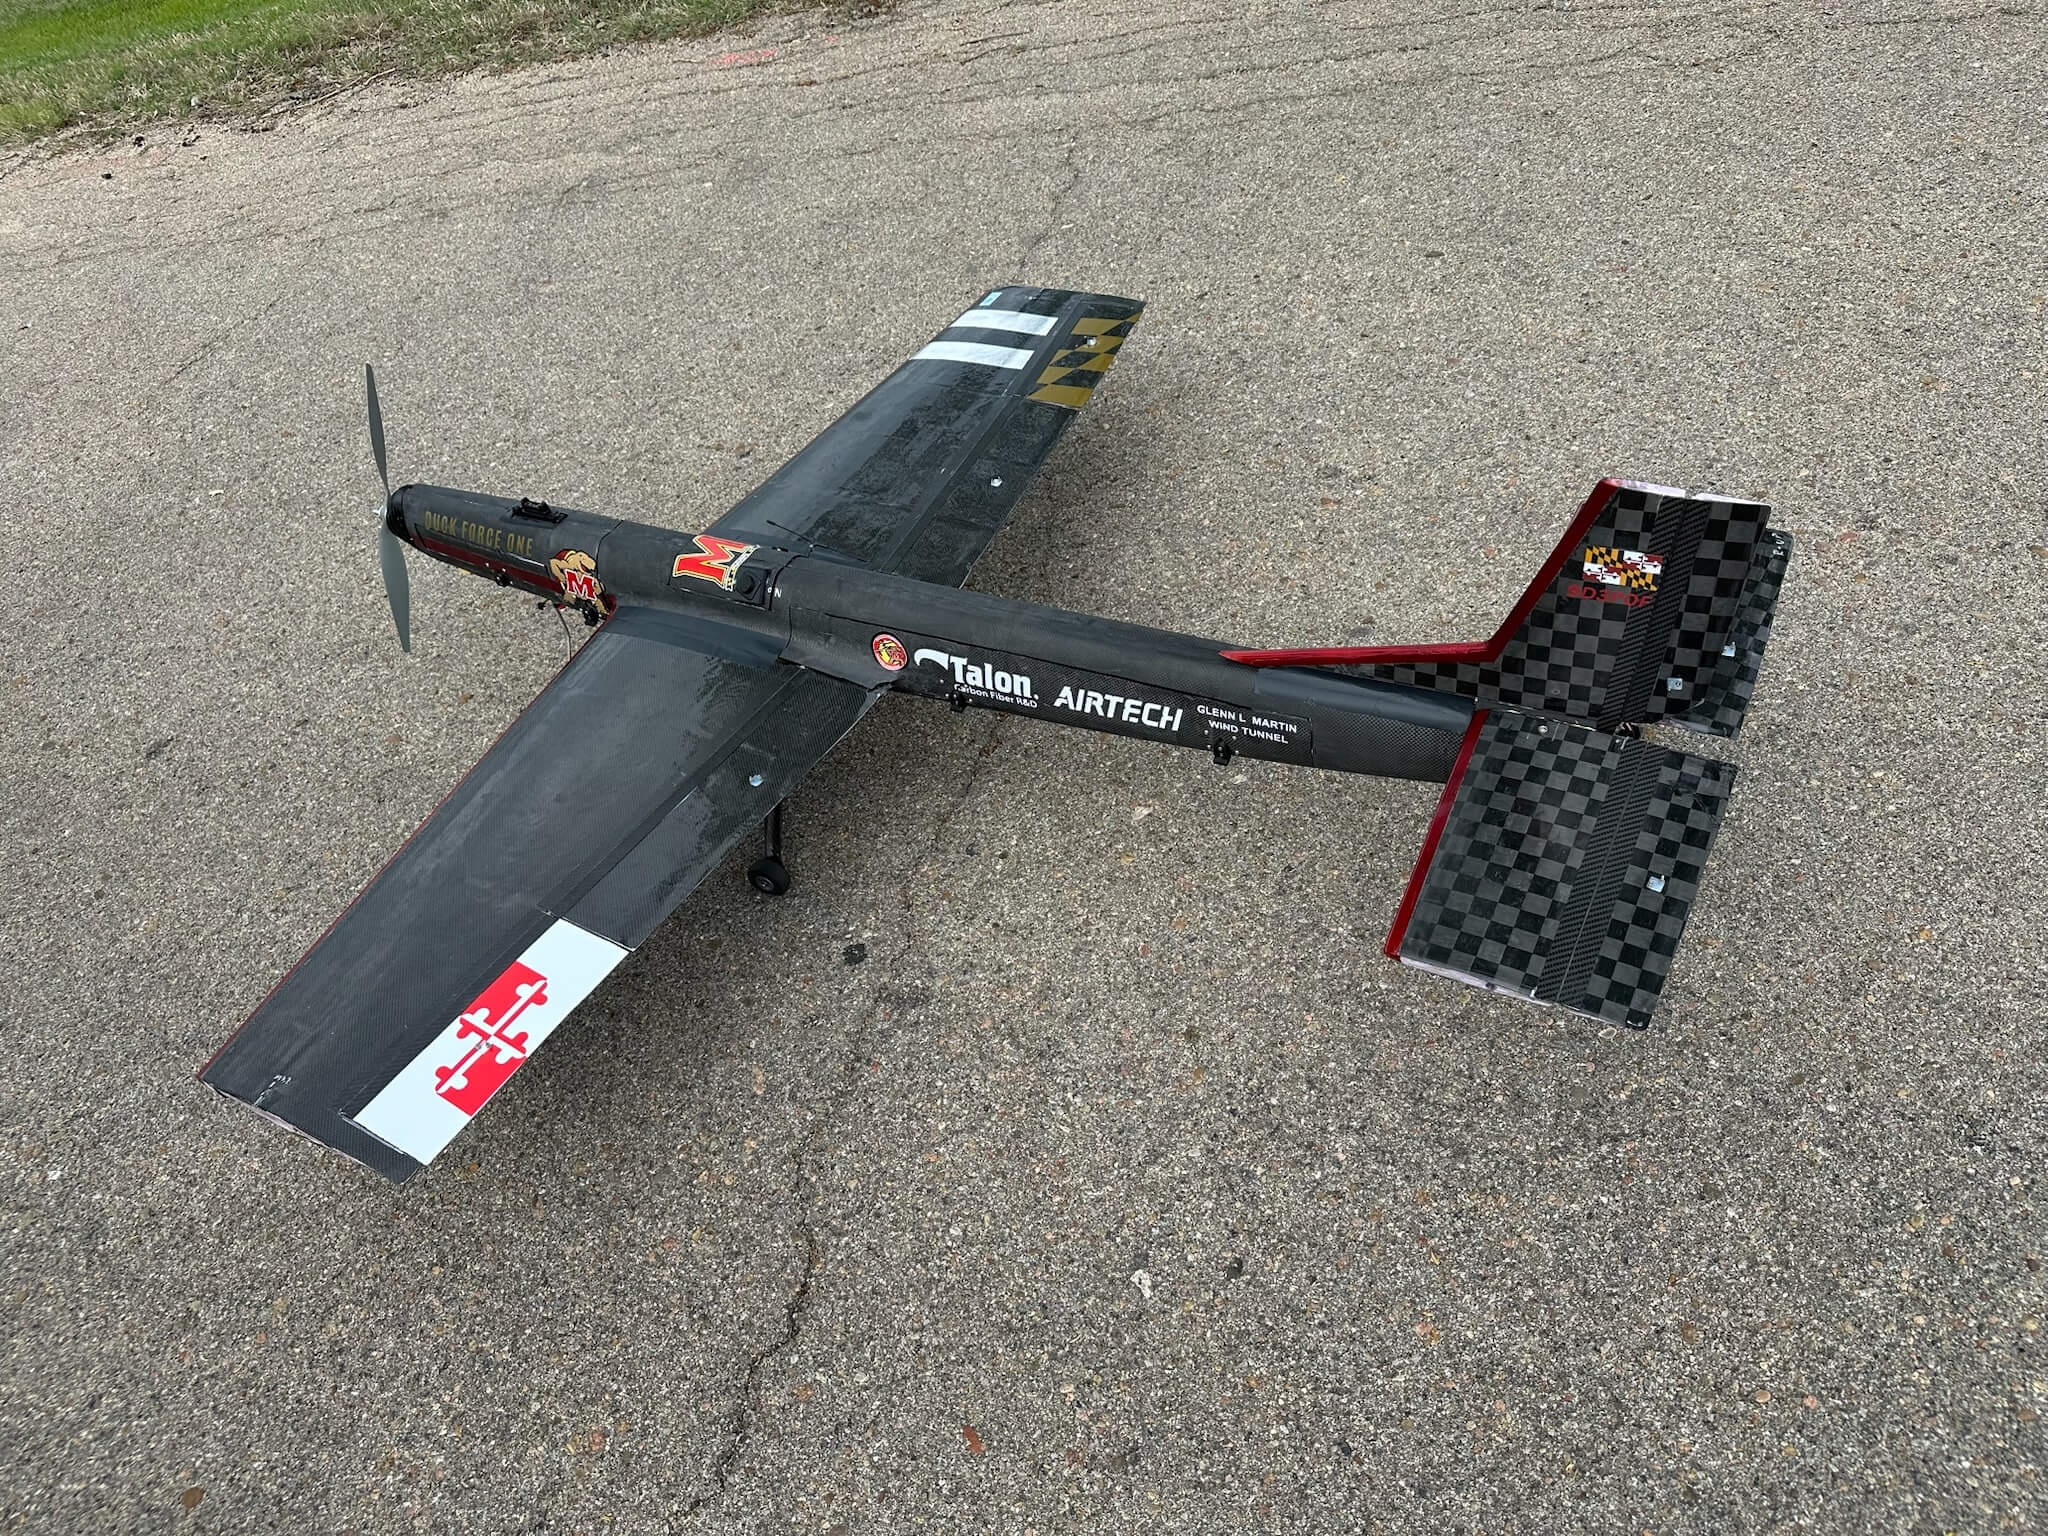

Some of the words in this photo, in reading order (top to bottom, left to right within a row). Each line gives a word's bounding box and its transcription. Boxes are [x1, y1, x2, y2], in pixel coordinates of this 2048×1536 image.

[424, 511, 457, 537] DUCK
[462, 520, 502, 549] FORCE
[507, 533, 533, 557] ONE
[564, 569, 598, 600] M
[990, 691, 1015, 704] Fiber
[1016, 697, 1038, 709] R&D
[1053, 685, 1184, 732] AIRTECH
[1196, 704, 1236, 721] GLENN
[1238, 712, 1247, 723] L
[1251, 716, 1298, 733] MARTIN
[1208, 719, 1239, 733] WIND
[1241, 726, 1289, 744] TUNNEL
